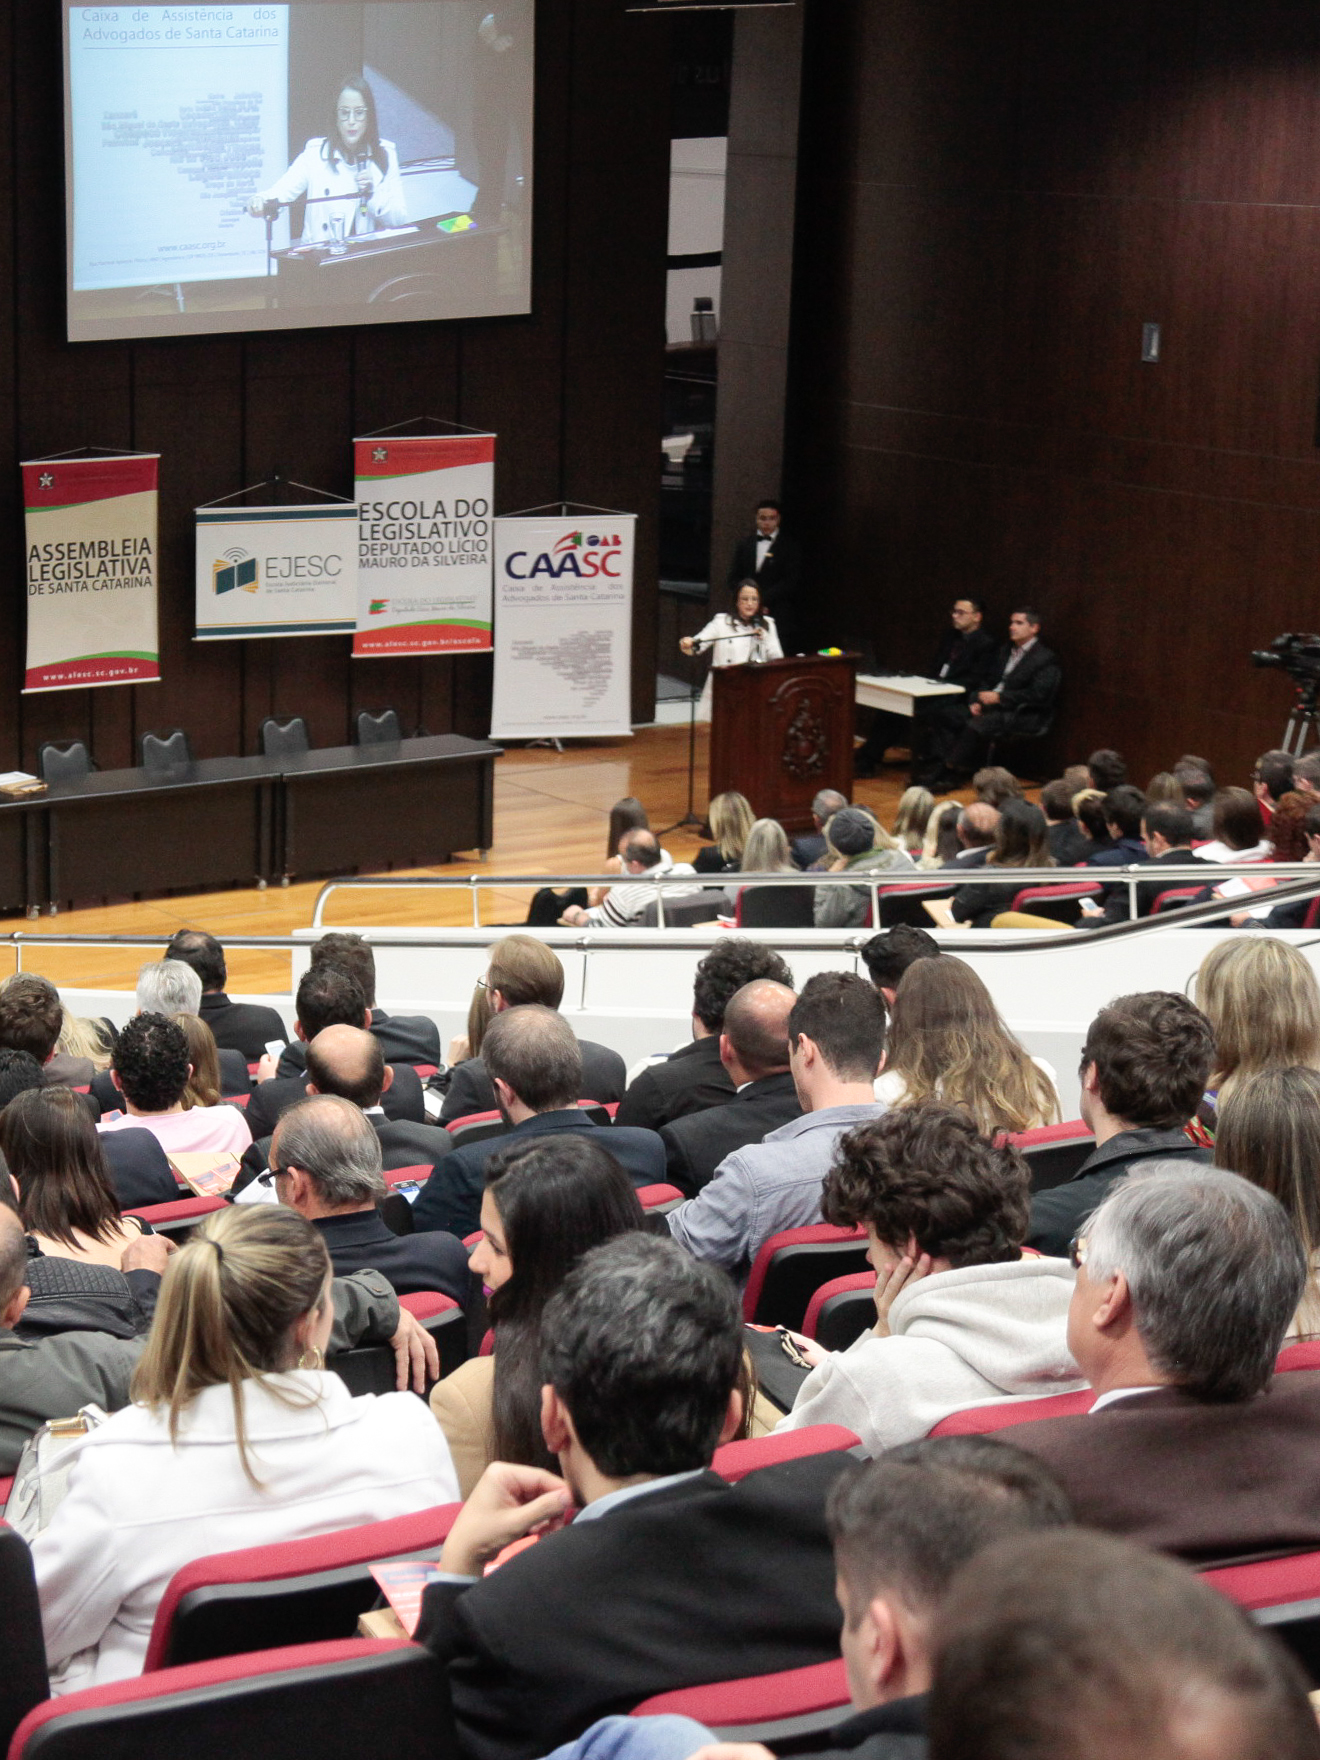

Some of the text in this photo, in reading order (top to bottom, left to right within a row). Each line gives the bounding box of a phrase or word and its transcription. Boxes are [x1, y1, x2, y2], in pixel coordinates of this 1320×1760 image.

[81, 8, 119, 22] Caixa
[131, 8, 149, 22] de
[253, 8, 276, 21] dos
[82, 25, 278, 43] Advogados de Santa Catarina
[359, 498, 488, 521] ESCOLA DO
[358, 520, 488, 541] LEGISLATIVO
[28, 537, 152, 563] ASSEMBLEIA
[358, 541, 445, 557] DEPUTADO
[29, 557, 152, 583] LEGISLATIVA
[265, 554, 342, 579] EJESC
[358, 553, 488, 569] MAURO DA SILVEIRA
[504, 550, 622, 580] CAASC
[28, 576, 153, 596] DE SANTA CATARINA
